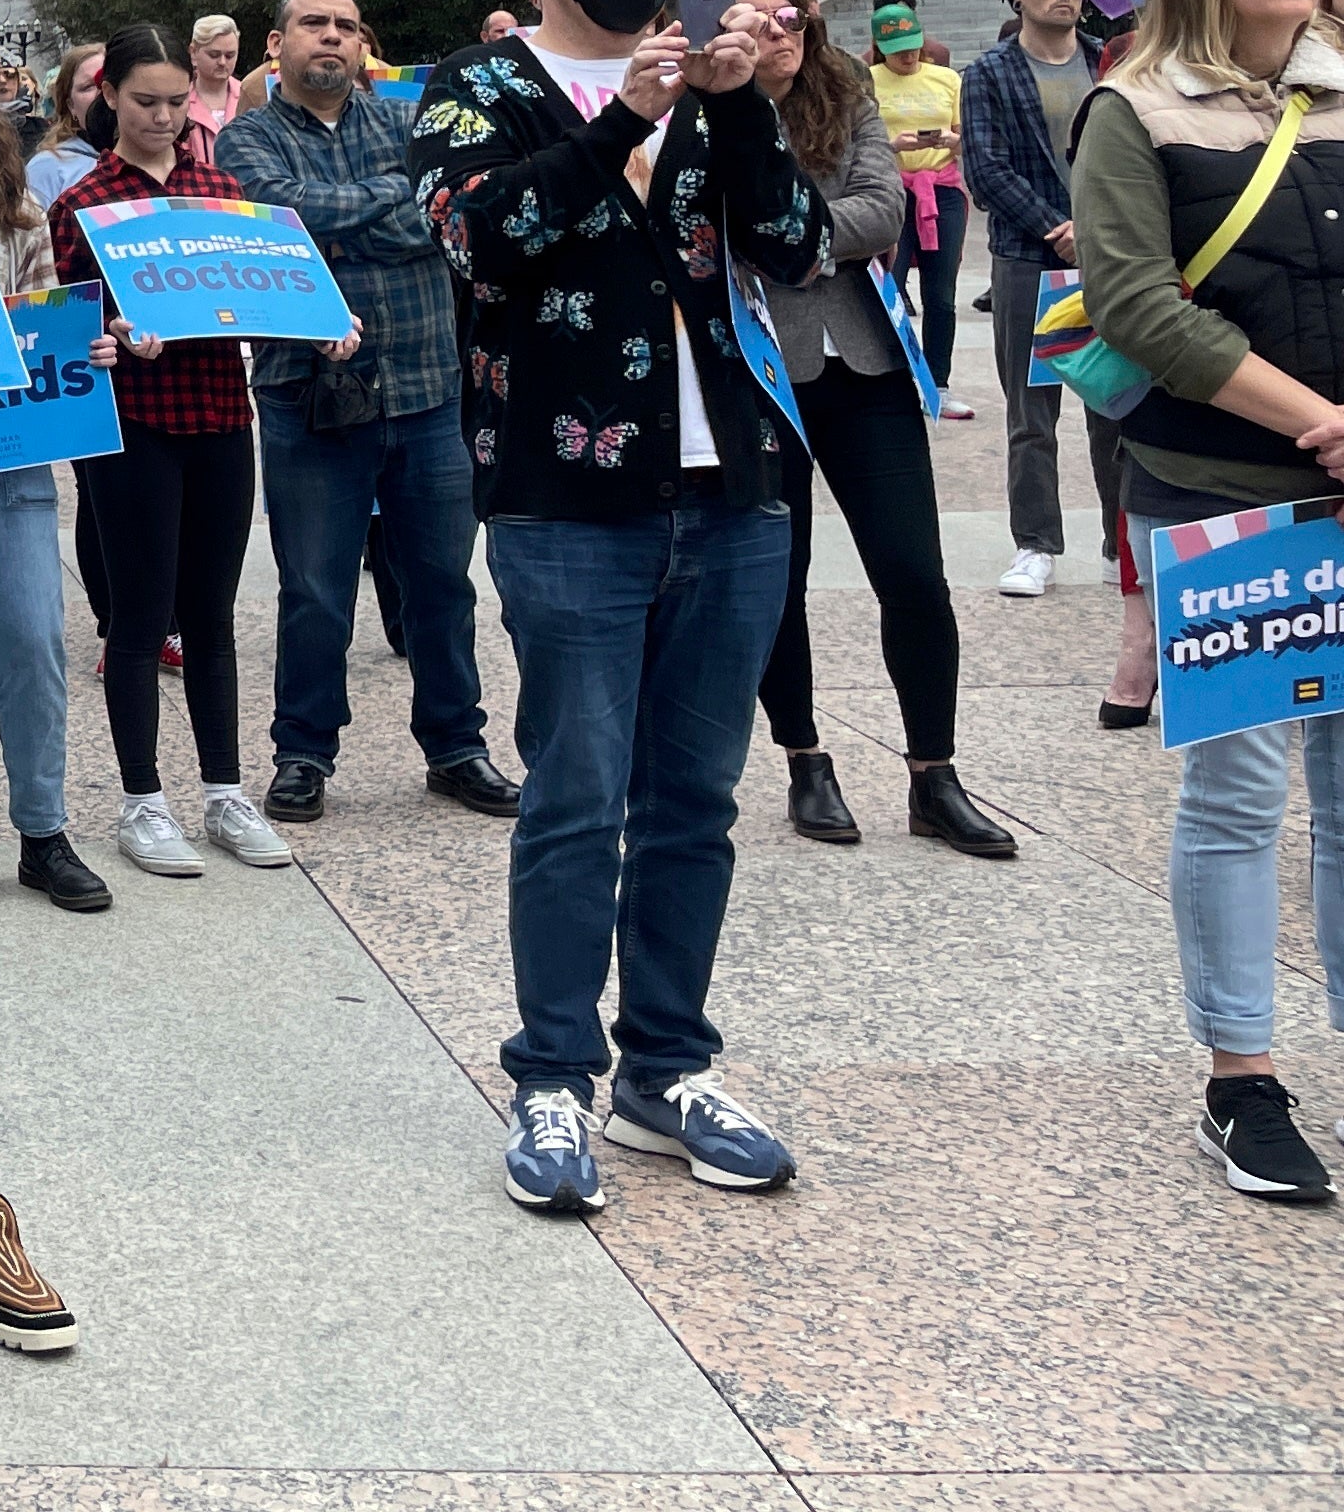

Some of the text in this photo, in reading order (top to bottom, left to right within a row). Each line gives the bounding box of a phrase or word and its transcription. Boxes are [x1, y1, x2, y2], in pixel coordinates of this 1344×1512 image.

[104, 236, 175, 260] trust
[132, 260, 317, 295] doctors
[1179, 569, 1290, 618] trust
[1173, 621, 1249, 665] not
